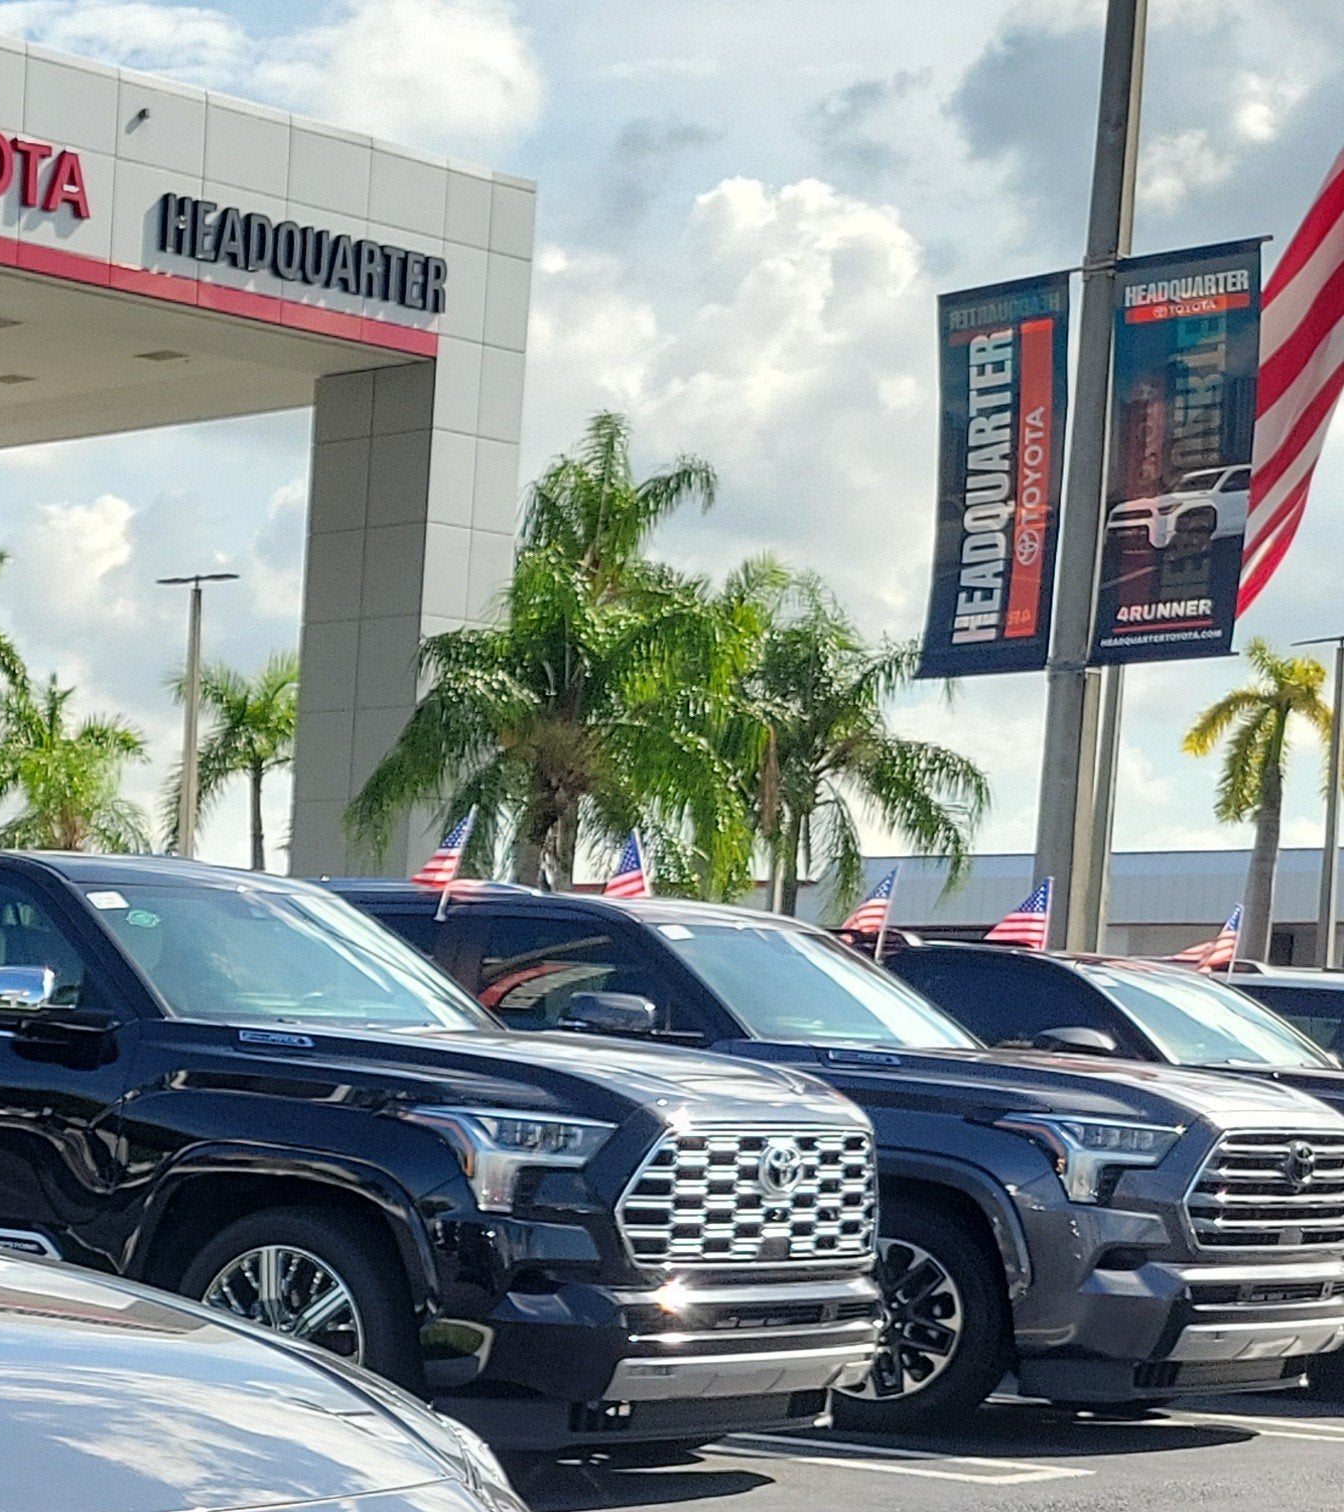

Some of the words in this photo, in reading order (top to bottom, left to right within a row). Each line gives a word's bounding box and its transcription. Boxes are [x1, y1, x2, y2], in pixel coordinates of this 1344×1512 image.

[159, 193, 448, 314] HEADQUARTER
[1124, 269, 1250, 307] HEADQUARTER
[1169, 299, 1216, 316] TOYOTA
[952, 327, 1015, 645] HEADQUARTER
[1019, 406, 1045, 529] TOYOTA
[1115, 599, 1212, 622] 4RUNNER
[1099, 629, 1223, 648] HEADQUARTERTOYOTA.COM
